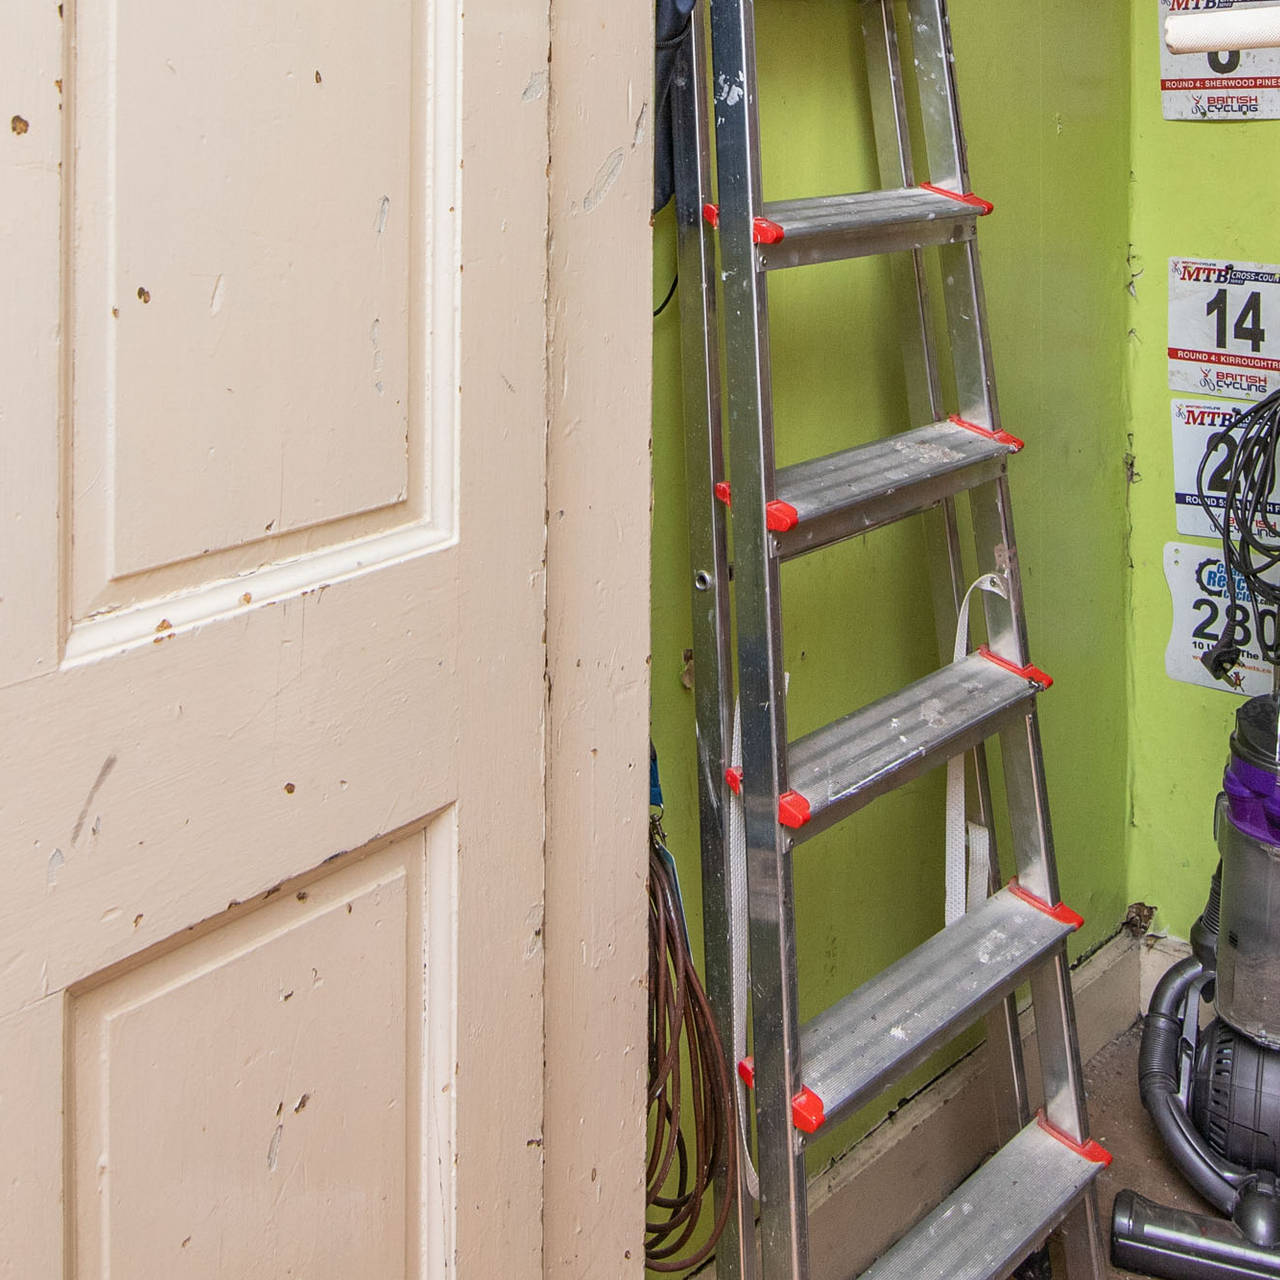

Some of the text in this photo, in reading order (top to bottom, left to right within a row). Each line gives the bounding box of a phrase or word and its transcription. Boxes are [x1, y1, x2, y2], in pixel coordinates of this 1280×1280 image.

[1165, 81, 1194, 89] ROUND
[1195, 80, 1203, 88] 4:
[1205, 79, 1255, 88] SHERWOOD
[1207, 96, 1258, 105] BRITISH
[1207, 104, 1258, 113] CYCLING
[1180, 266, 1229, 285] MTB
[1206, 288, 1265, 353] 14
[1177, 351, 1208, 361] ROUND
[1216, 371, 1268, 385] BRITISH
[1216, 380, 1267, 393] CYCLING
[1184, 410, 1234, 428] MTB
[1192, 641, 1204, 650] 10
[1240, 649, 1260, 661] The
